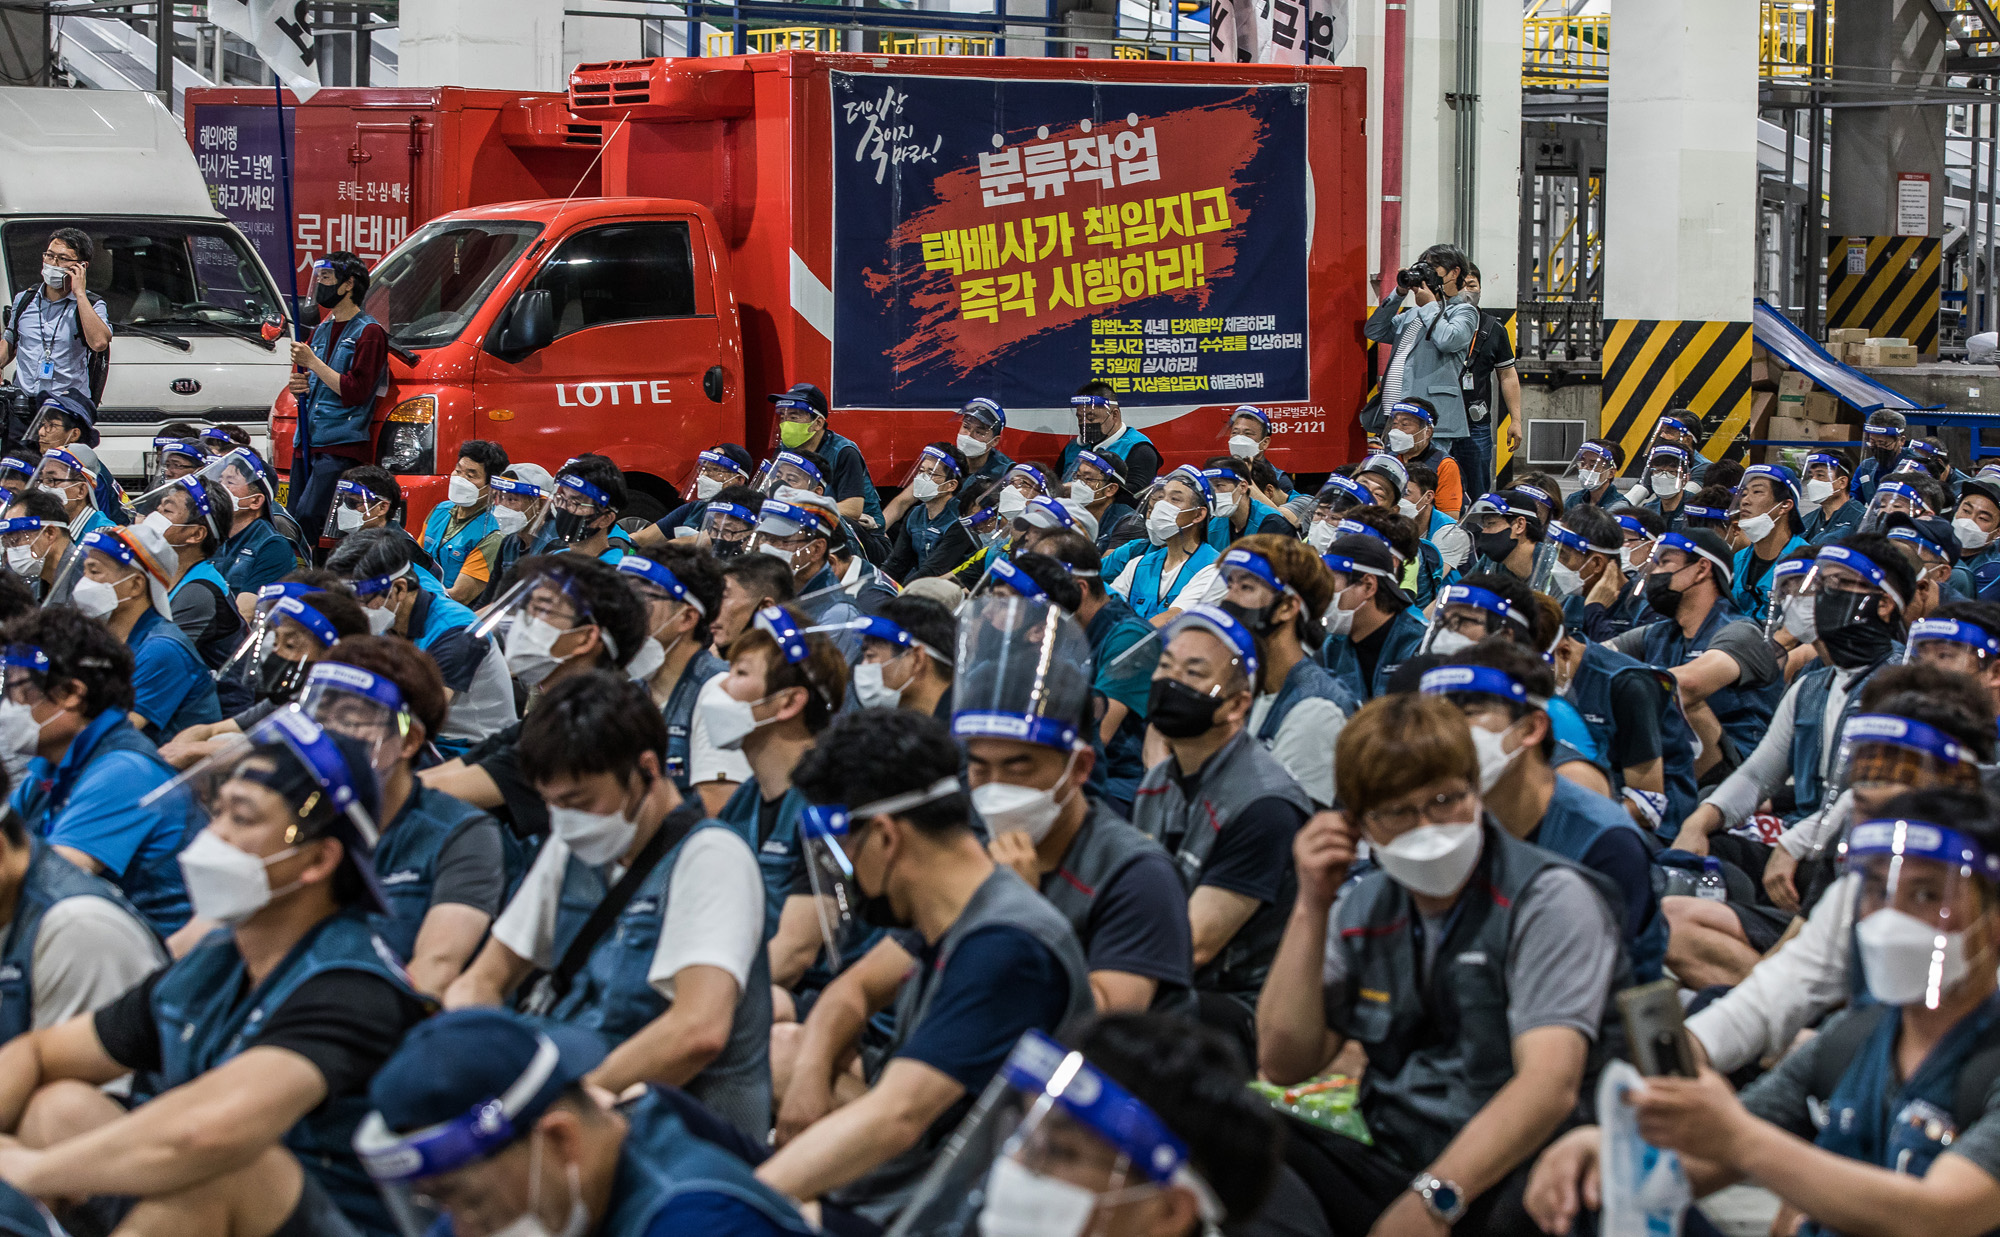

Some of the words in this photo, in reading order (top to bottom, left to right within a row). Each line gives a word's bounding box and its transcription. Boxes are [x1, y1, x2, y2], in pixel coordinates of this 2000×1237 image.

[200, 125, 238, 151] 해외여행
[200, 154, 218, 178] 다시
[220, 154, 240, 178] 가는
[241, 155, 251, 176] 그
[253, 154, 275, 182] 날엔,
[978, 126, 1161, 208] 분류작업
[207, 184, 239, 210] 럭하고
[240, 185, 275, 211] 가세요!
[921, 211, 1076, 277] 택배사가
[1082, 186, 1232, 250] 책임지고
[960, 271, 1037, 324] 즉각
[1048, 242, 1206, 311] 시행하라!
[1091, 319, 1143, 335] 합법노조
[1171, 318, 1224, 334] 단체협약
[1224, 314, 1276, 332] 체결하라!
[1090, 338, 1143, 354] 노동시간
[1145, 337, 1198, 354] 단축하고
[1199, 335, 1248, 353] 수수료를
[1249, 333, 1302, 351] 인상하라!
[1091, 358, 1105, 374] 주
[1106, 357, 1142, 374] 5일제
[1142, 356, 1198, 373] 실시하라!
[175, 379, 198, 391] KIA
[556, 380, 672, 407] LOTTE
[1132, 375, 1209, 393] 지상출입금지
[1209, 372, 1264, 390] 해결하라!
[1260, 406, 1327, 418] 데글로벌로지스
